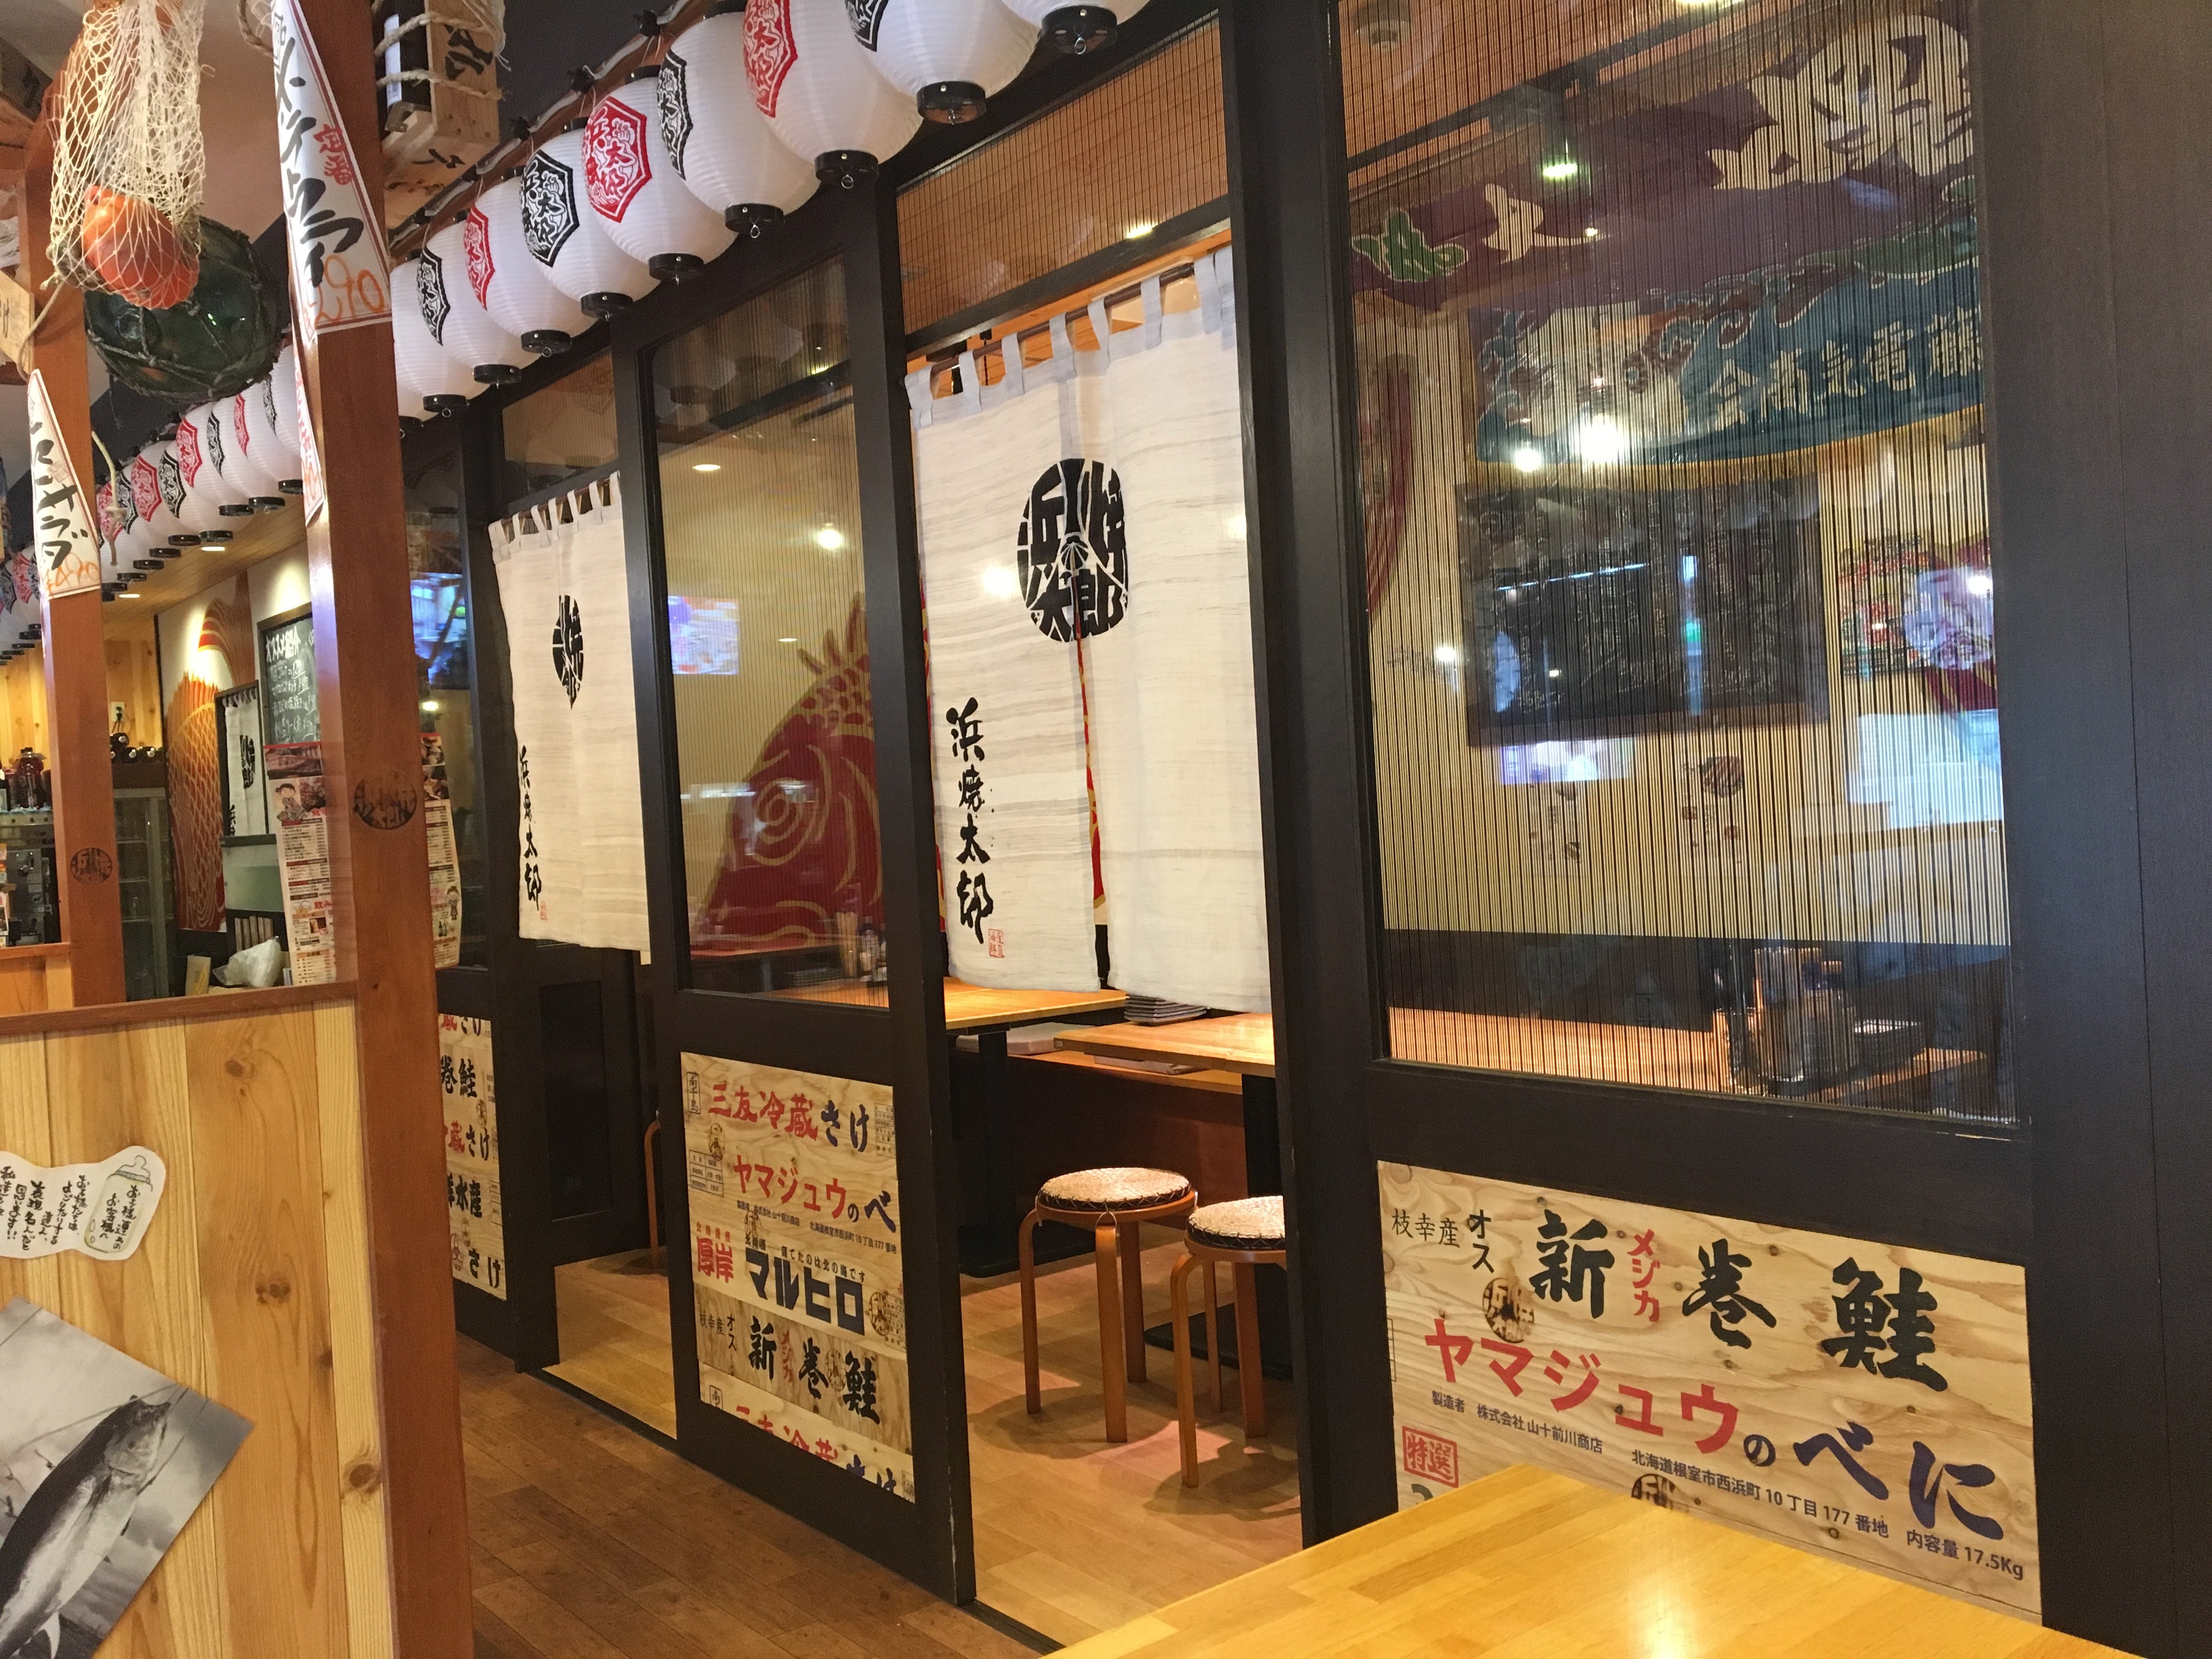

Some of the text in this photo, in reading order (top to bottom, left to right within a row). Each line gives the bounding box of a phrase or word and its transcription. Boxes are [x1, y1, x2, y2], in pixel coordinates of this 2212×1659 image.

[946, 697, 994, 944] 浜焼太郎
[445, 1120, 489, 1161] 蔵さけ
[1391, 1208, 1460, 1248] 枝幸産
[1468, 1208, 1495, 1273] オス
[469, 1249, 501, 1289] さけ
[697, 1235, 734, 1284] 厚岸
[1627, 1229, 1661, 1323] メジカ
[746, 1247, 865, 1336] マルヒロ
[699, 1313, 723, 1335] 枝幸産
[727, 1313, 736, 1351] オス
[1406, 1432, 1454, 1481] 特選
[1432, 1391, 1465, 1413] 製造者
[1477, 1404, 1525, 1431] 株式会社
[1527, 1419, 1604, 1455] 山十前川商店
[1631, 1449, 1760, 1502] 北海道根室市西浜町
[1766, 1488, 1784, 1506] 10
[1787, 1494, 1818, 1517] 丁目
[1823, 1505, 1850, 1526] 177
[1855, 1515, 1889, 1539] 番地
[1906, 1529, 1960, 1560] 内容量
[1965, 1546, 2024, 1581] 17.5Kg
